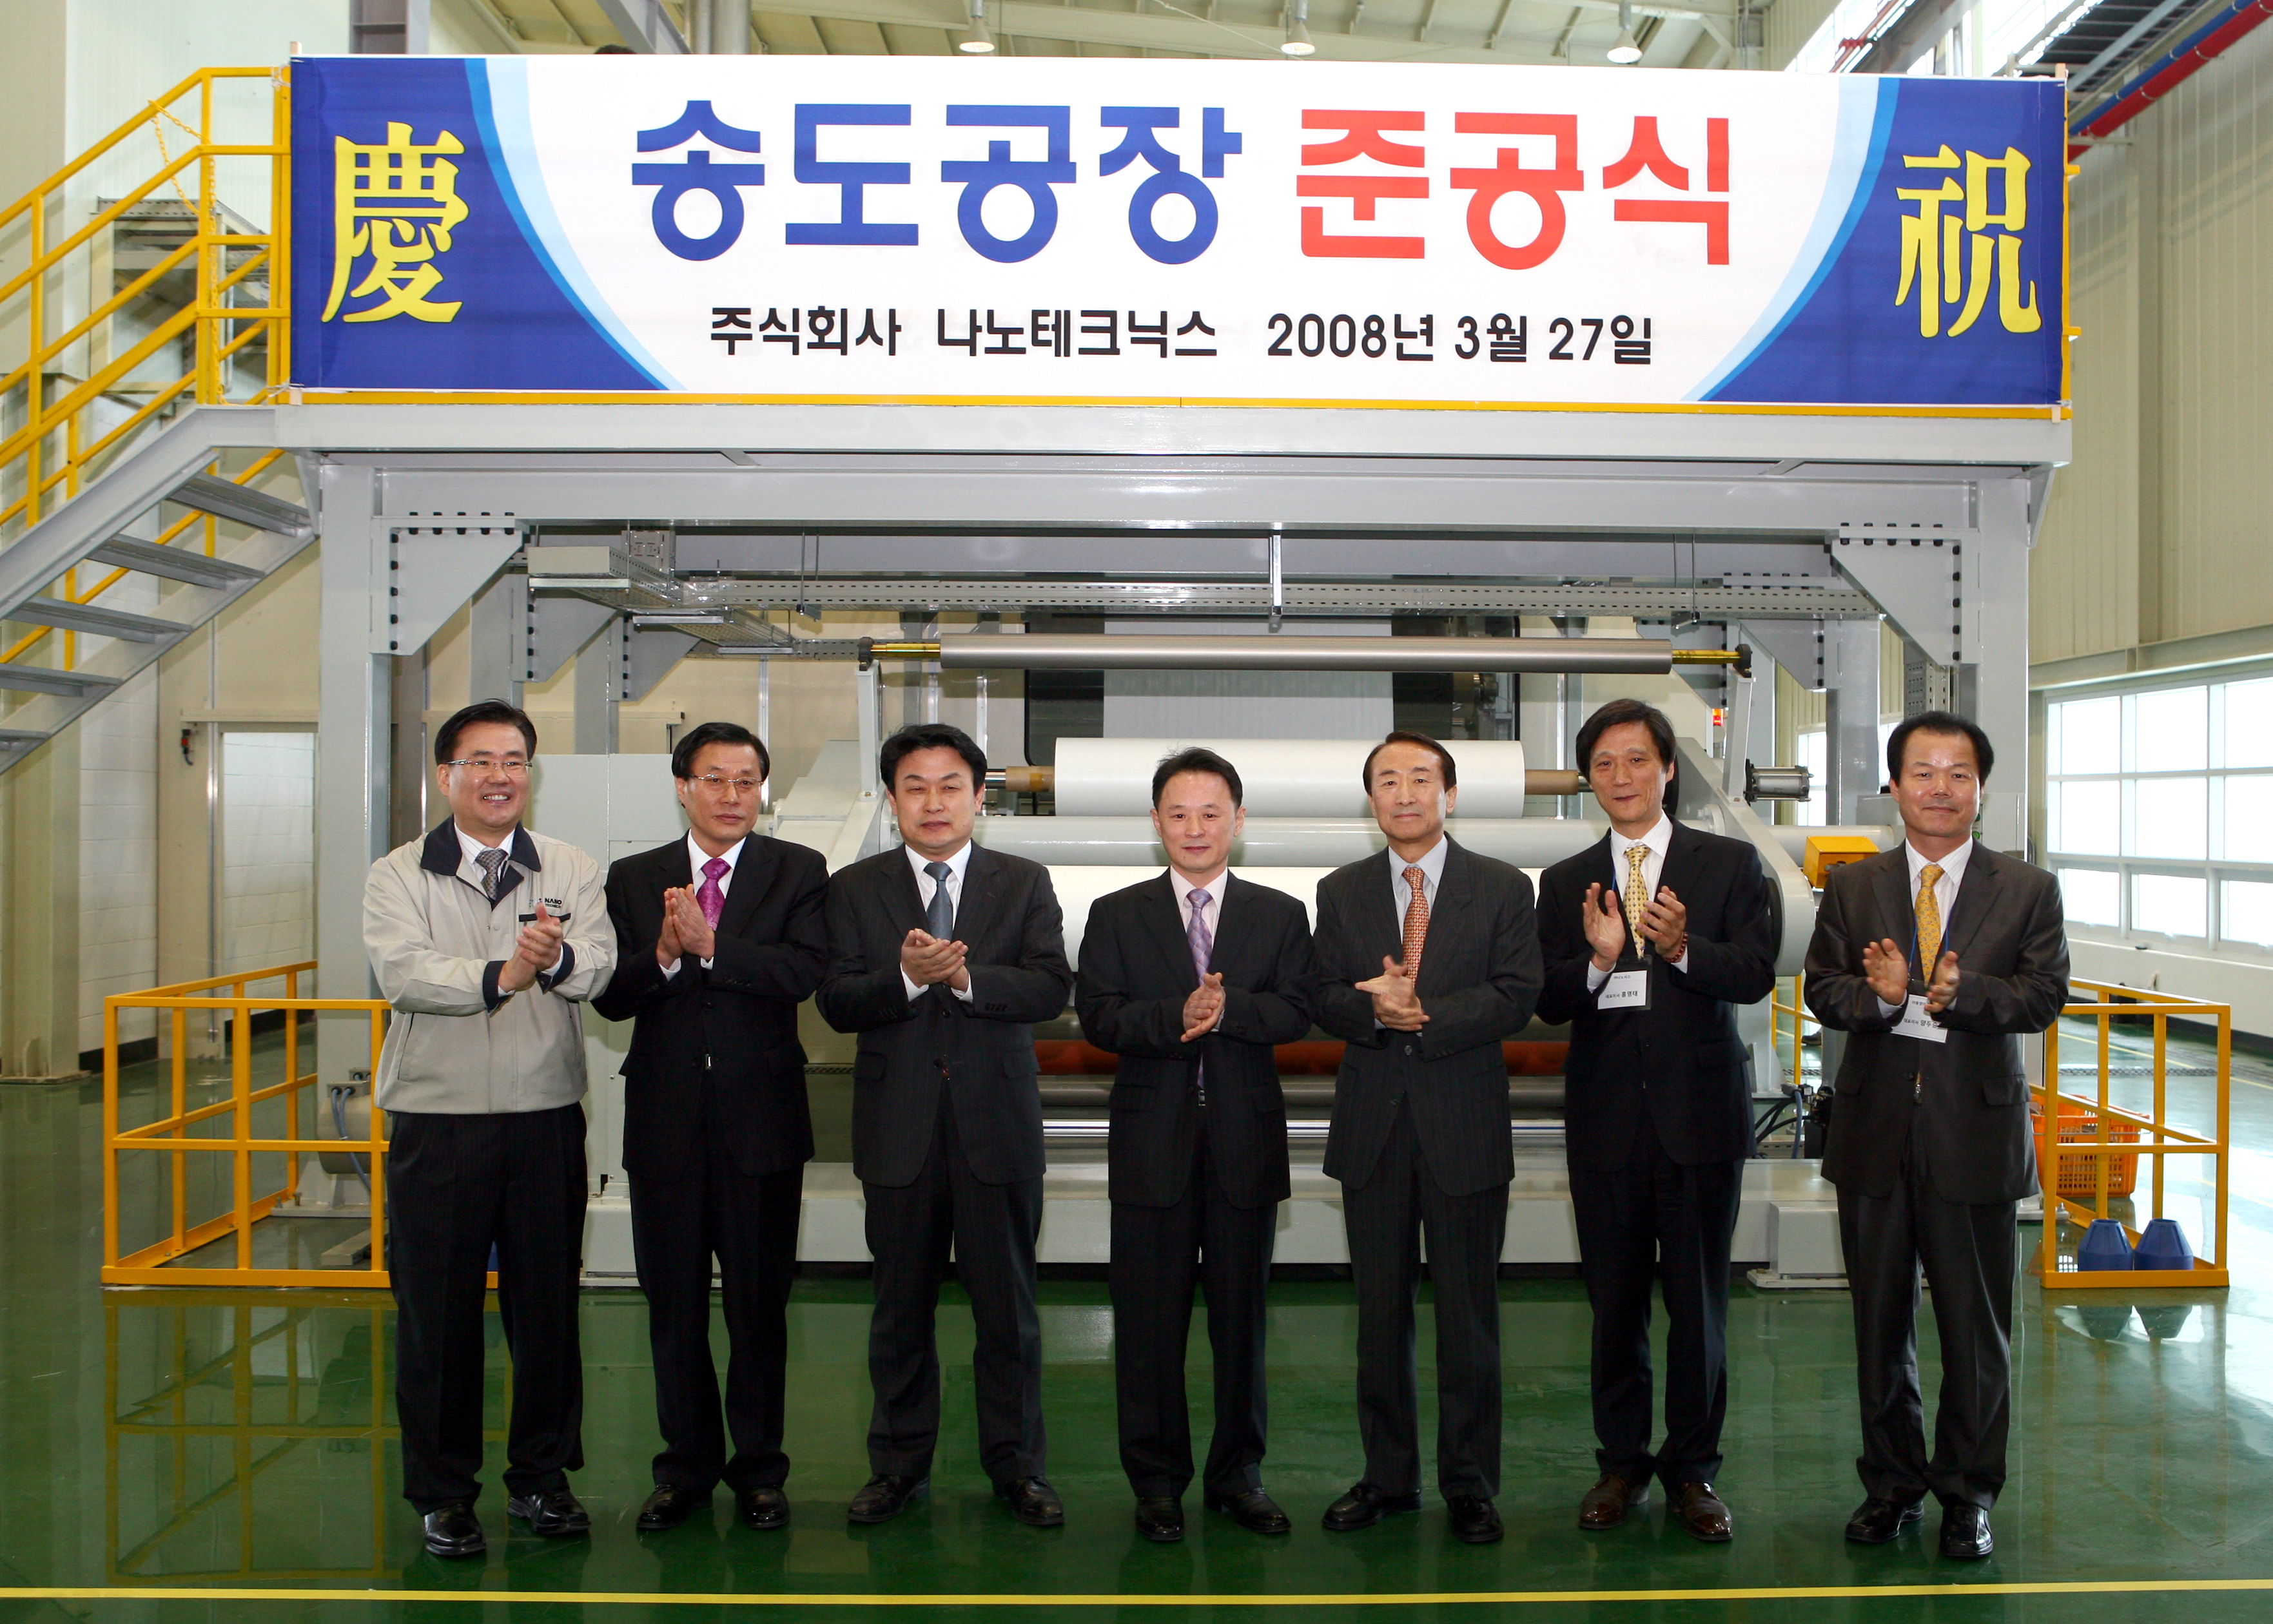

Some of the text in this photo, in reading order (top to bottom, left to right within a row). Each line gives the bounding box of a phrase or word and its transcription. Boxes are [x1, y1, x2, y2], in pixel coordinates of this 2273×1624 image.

[322, 121, 469, 323] 慶
[632, 100, 1730, 271] 송도공장 준공식
[1895, 144, 2042, 338] 祝
[711, 306, 1652, 365] 주식회사 나노테크닉스 2008년 3월 27일
